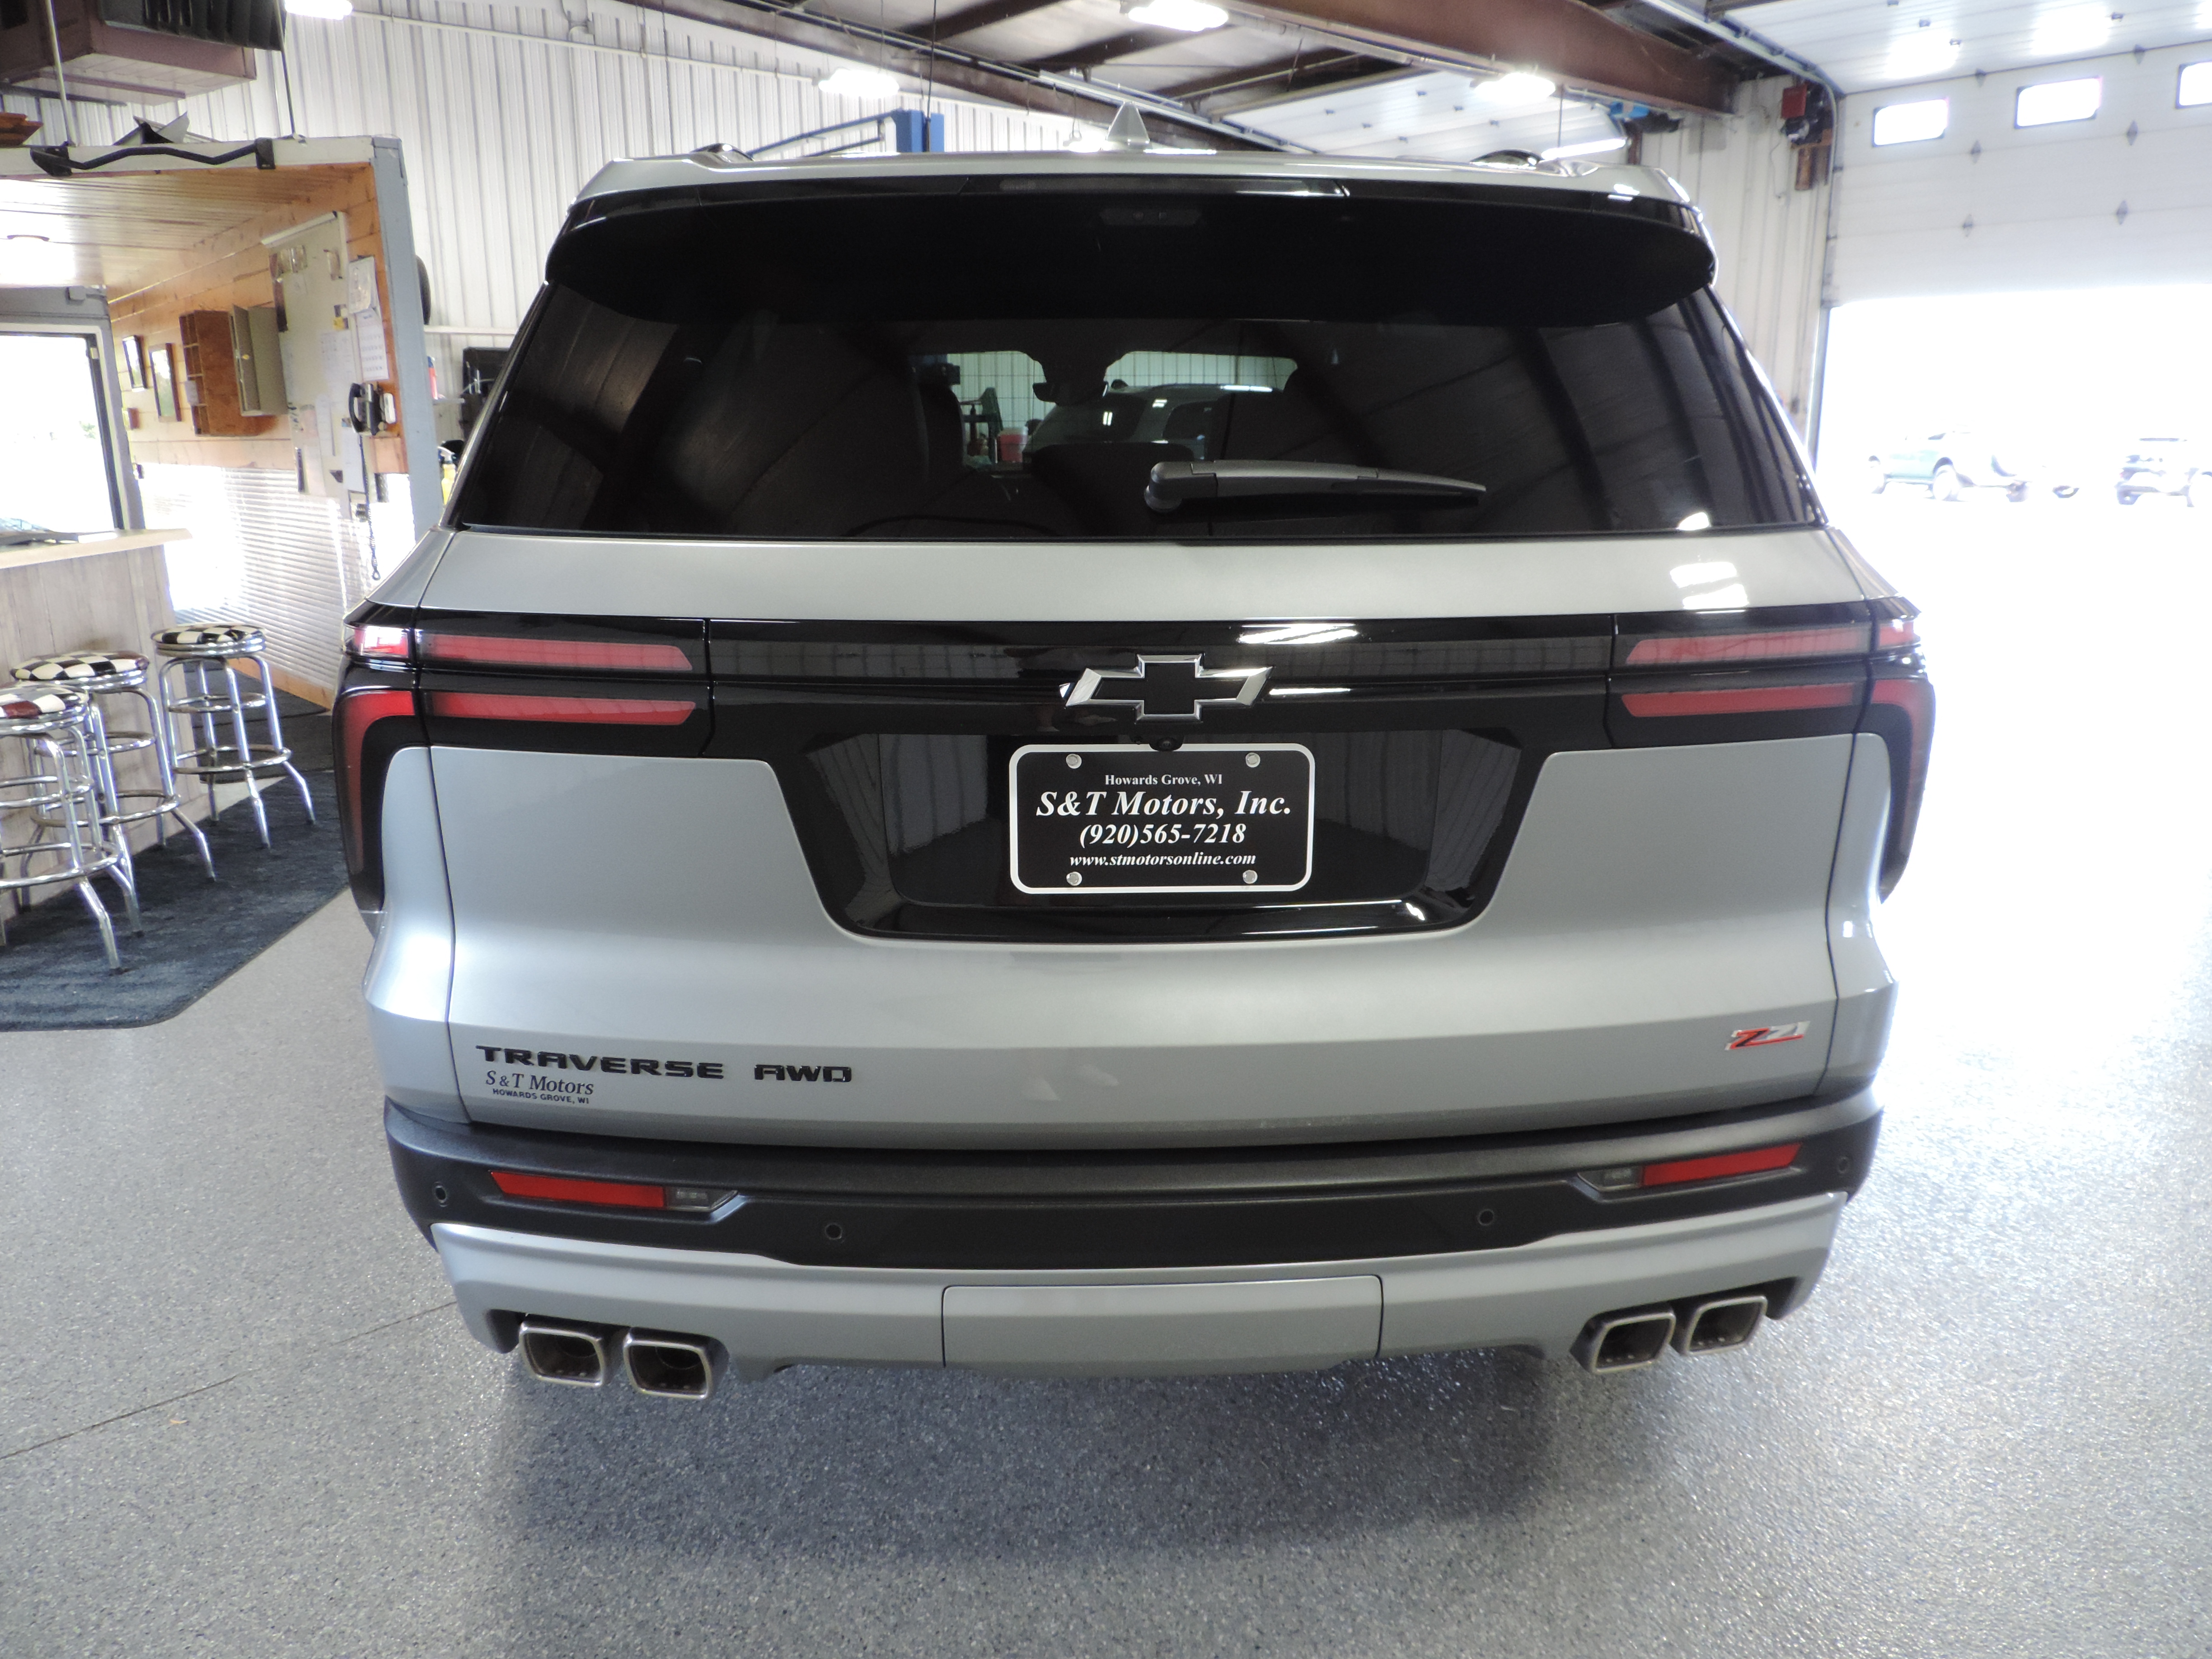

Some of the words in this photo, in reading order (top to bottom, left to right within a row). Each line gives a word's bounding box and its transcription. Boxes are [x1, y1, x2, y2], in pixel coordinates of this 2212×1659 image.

[1105, 774, 1158, 785] Howards
[1161, 774, 1201, 786] Grove,
[1204, 774, 1222, 785] WI
[1036, 791, 1106, 816] S&T
[1112, 791, 1224, 820] Motors,
[1234, 791, 1291, 815] Inc.
[1079, 823, 1247, 848] (920)565-7218
[1070, 852, 1256, 866] www.stmotorsonline.com
[476, 1045, 724, 1079] TRAVERSE
[754, 1064, 853, 1083] AWD
[492, 1088, 538, 1099] HOWARDS
[540, 1093, 575, 1104] GROVE,
[529, 1075, 594, 1096] Motors
